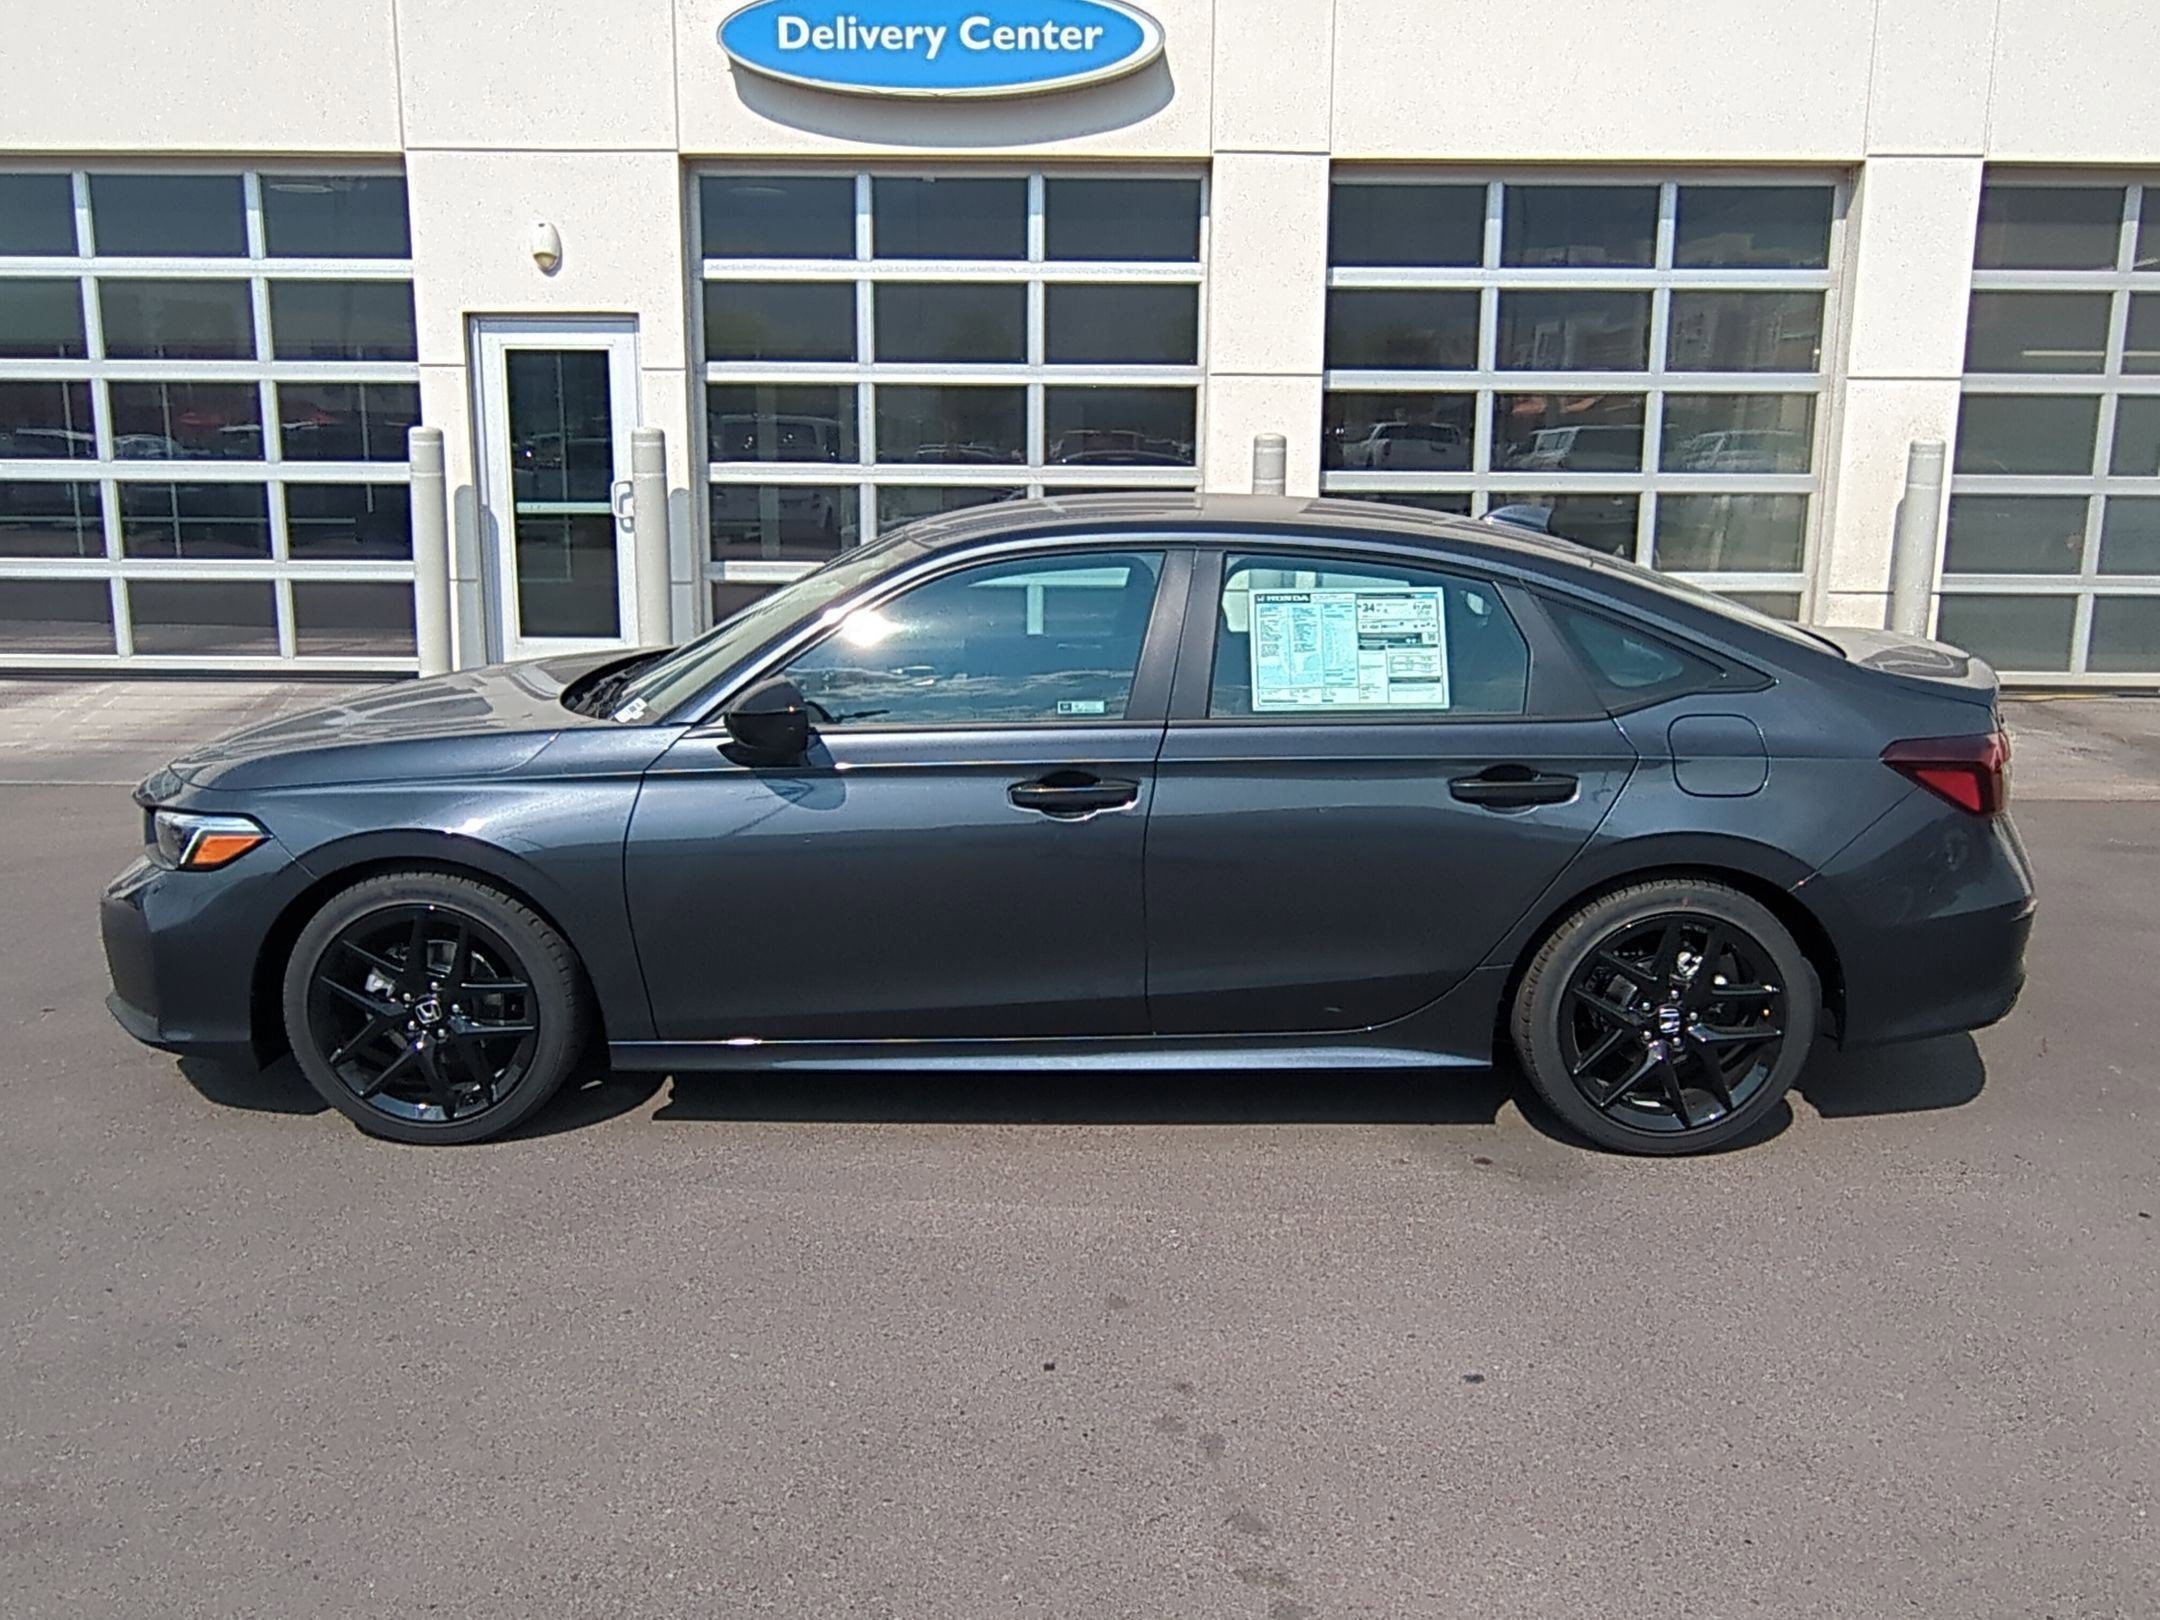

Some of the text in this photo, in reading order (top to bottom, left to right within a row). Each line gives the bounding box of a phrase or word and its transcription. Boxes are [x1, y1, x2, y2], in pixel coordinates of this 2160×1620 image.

[778, 15, 1104, 59] Delivery Center
[1266, 594, 1309, 602] HONDA
